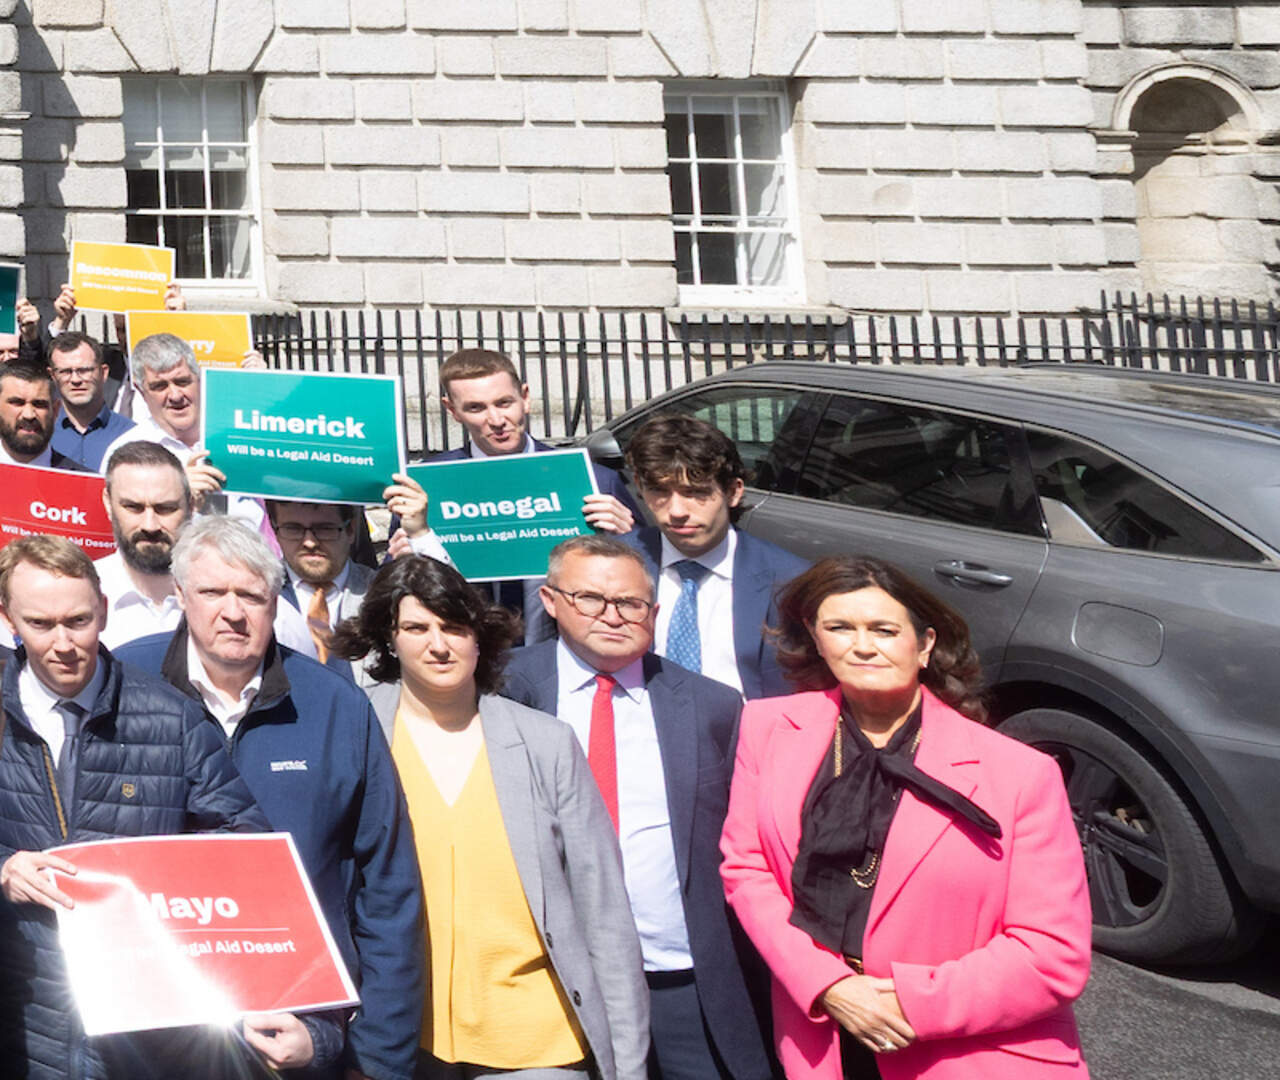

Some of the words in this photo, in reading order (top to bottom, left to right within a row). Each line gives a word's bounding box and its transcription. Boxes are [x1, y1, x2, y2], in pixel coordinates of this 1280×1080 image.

[235, 409, 366, 439] Limerick
[227, 443, 249, 455] Will
[250, 446, 265, 456] be
[267, 449, 275, 458] a
[277, 448, 309, 461] Legal
[311, 451, 331, 462] Aid
[333, 454, 374, 466] Desert
[30, 502, 87, 525] Cork
[440, 491, 562, 520] Donegal
[460, 532, 475, 542] be
[477, 533, 485, 541] a
[486, 530, 517, 542] Legal
[519, 528, 538, 538] Aid
[540, 526, 580, 537] Desert
[142, 892, 240, 925] Mayo
[215, 939, 241, 953] Aid
[242, 939, 296, 953] Desert
